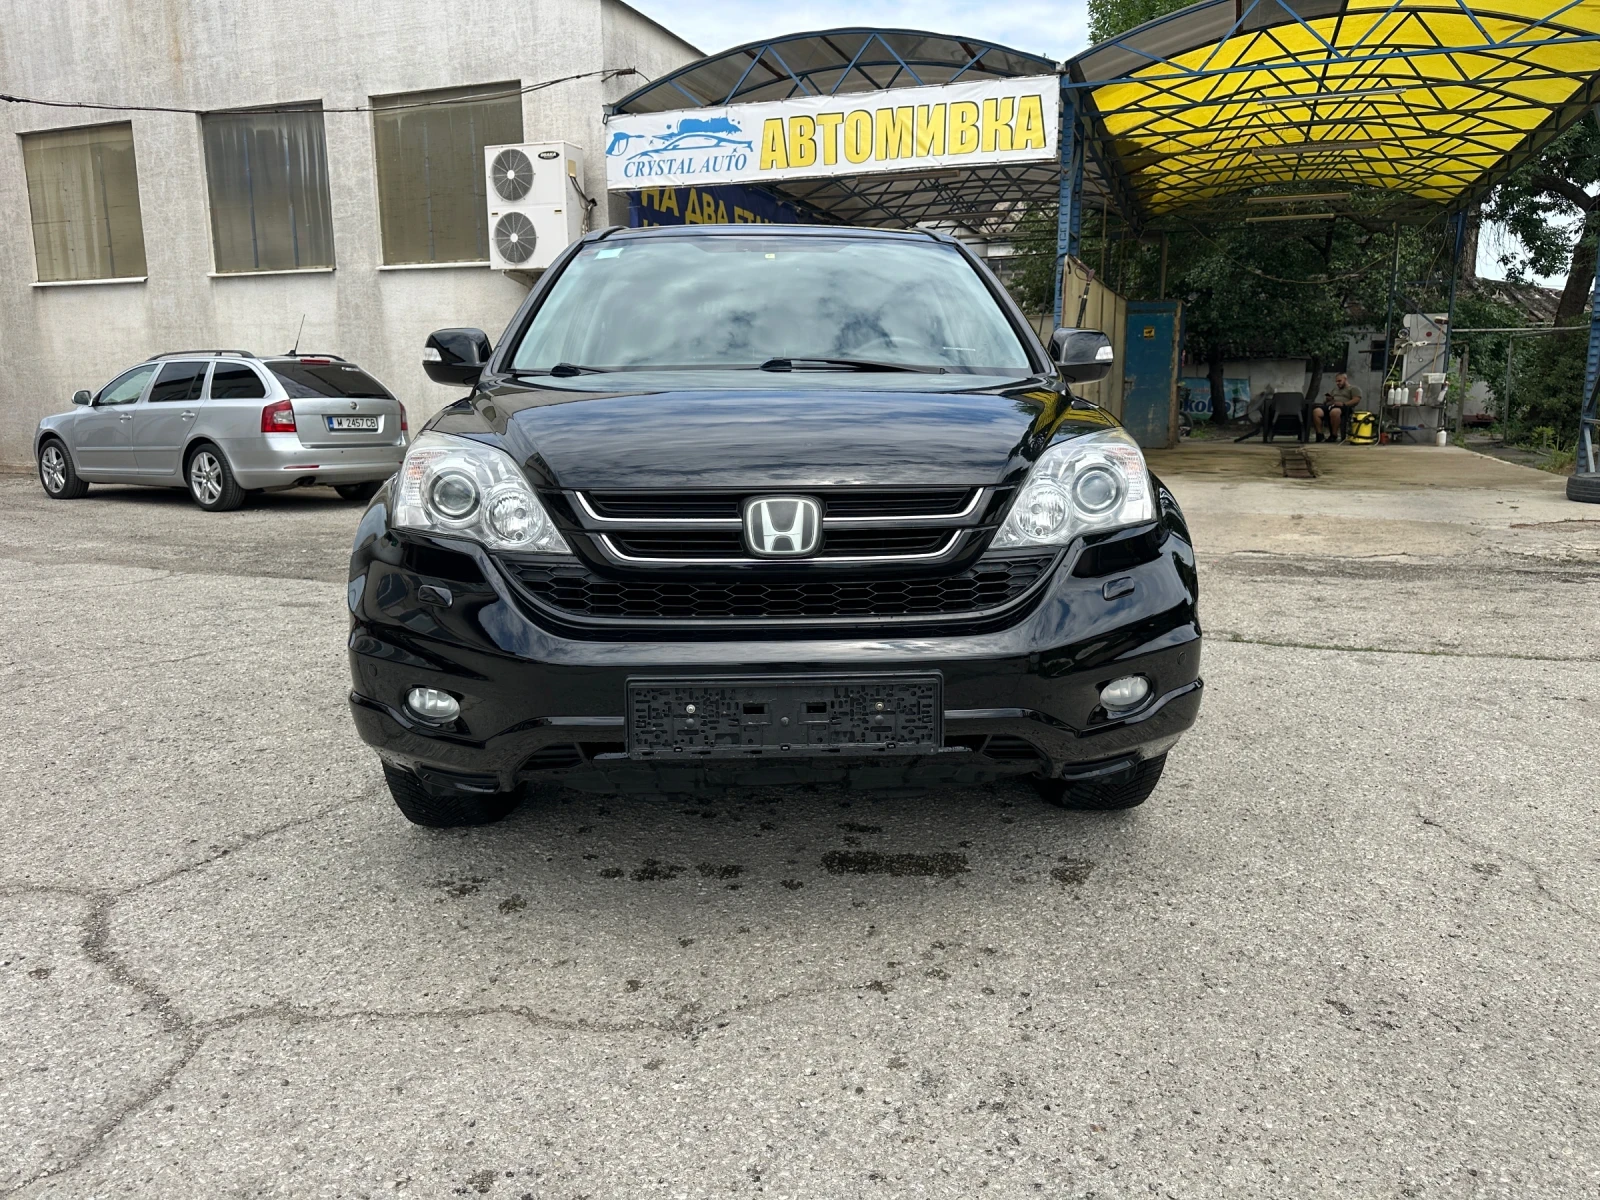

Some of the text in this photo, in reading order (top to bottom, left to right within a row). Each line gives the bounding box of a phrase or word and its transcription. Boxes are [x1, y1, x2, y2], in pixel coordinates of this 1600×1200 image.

[759, 94, 1047, 170] АВТОМИВКА
[624, 153, 747, 178] CRYSTAL AUTO
[641, 187, 680, 217] НА
[685, 187, 729, 225] ДВА
[346, 418, 365, 428] 2457
